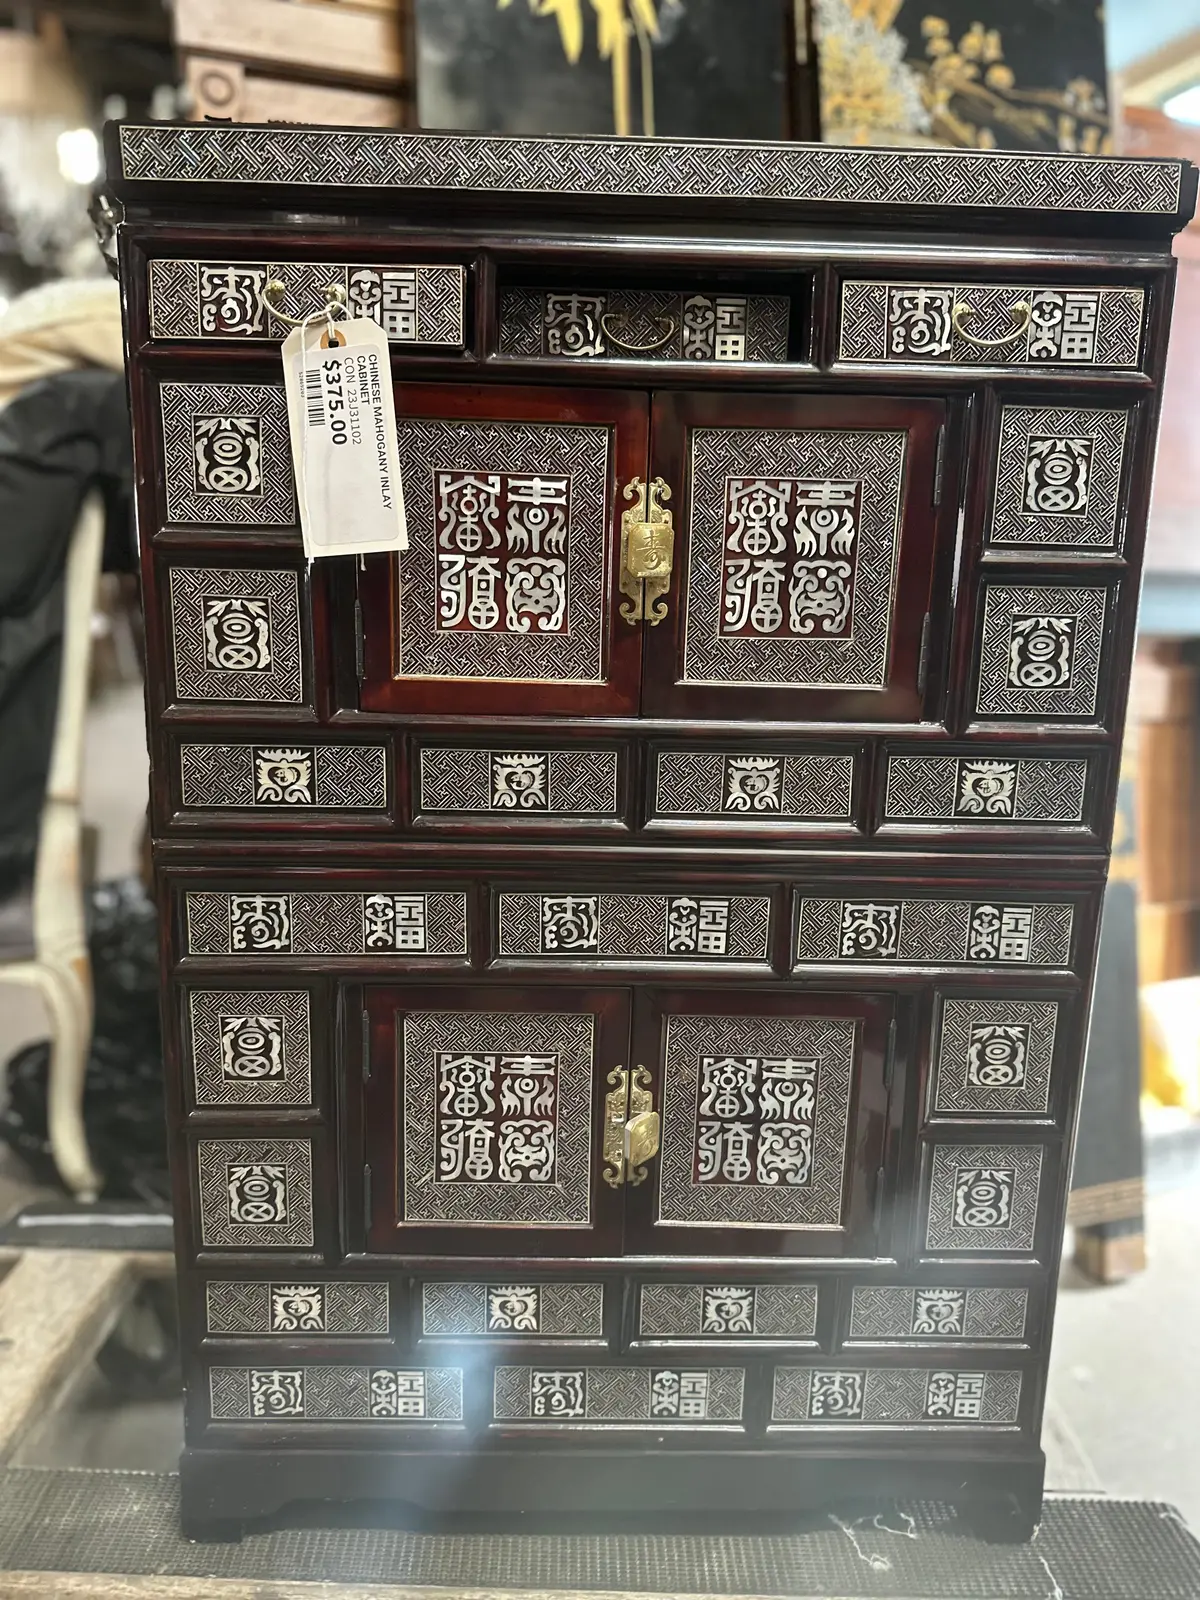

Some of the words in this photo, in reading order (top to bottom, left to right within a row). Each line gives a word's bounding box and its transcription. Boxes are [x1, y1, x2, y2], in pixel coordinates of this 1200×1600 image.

[344, 357, 356, 384] CON
[357, 355, 370, 405] CABINET
[368, 354, 382, 404] CHINESE
[322, 359, 348, 445] $375.00
[347, 389, 362, 445] 23J31102
[373, 406, 388, 474] MAHOGANY
[380, 476, 392, 510] INLAY
